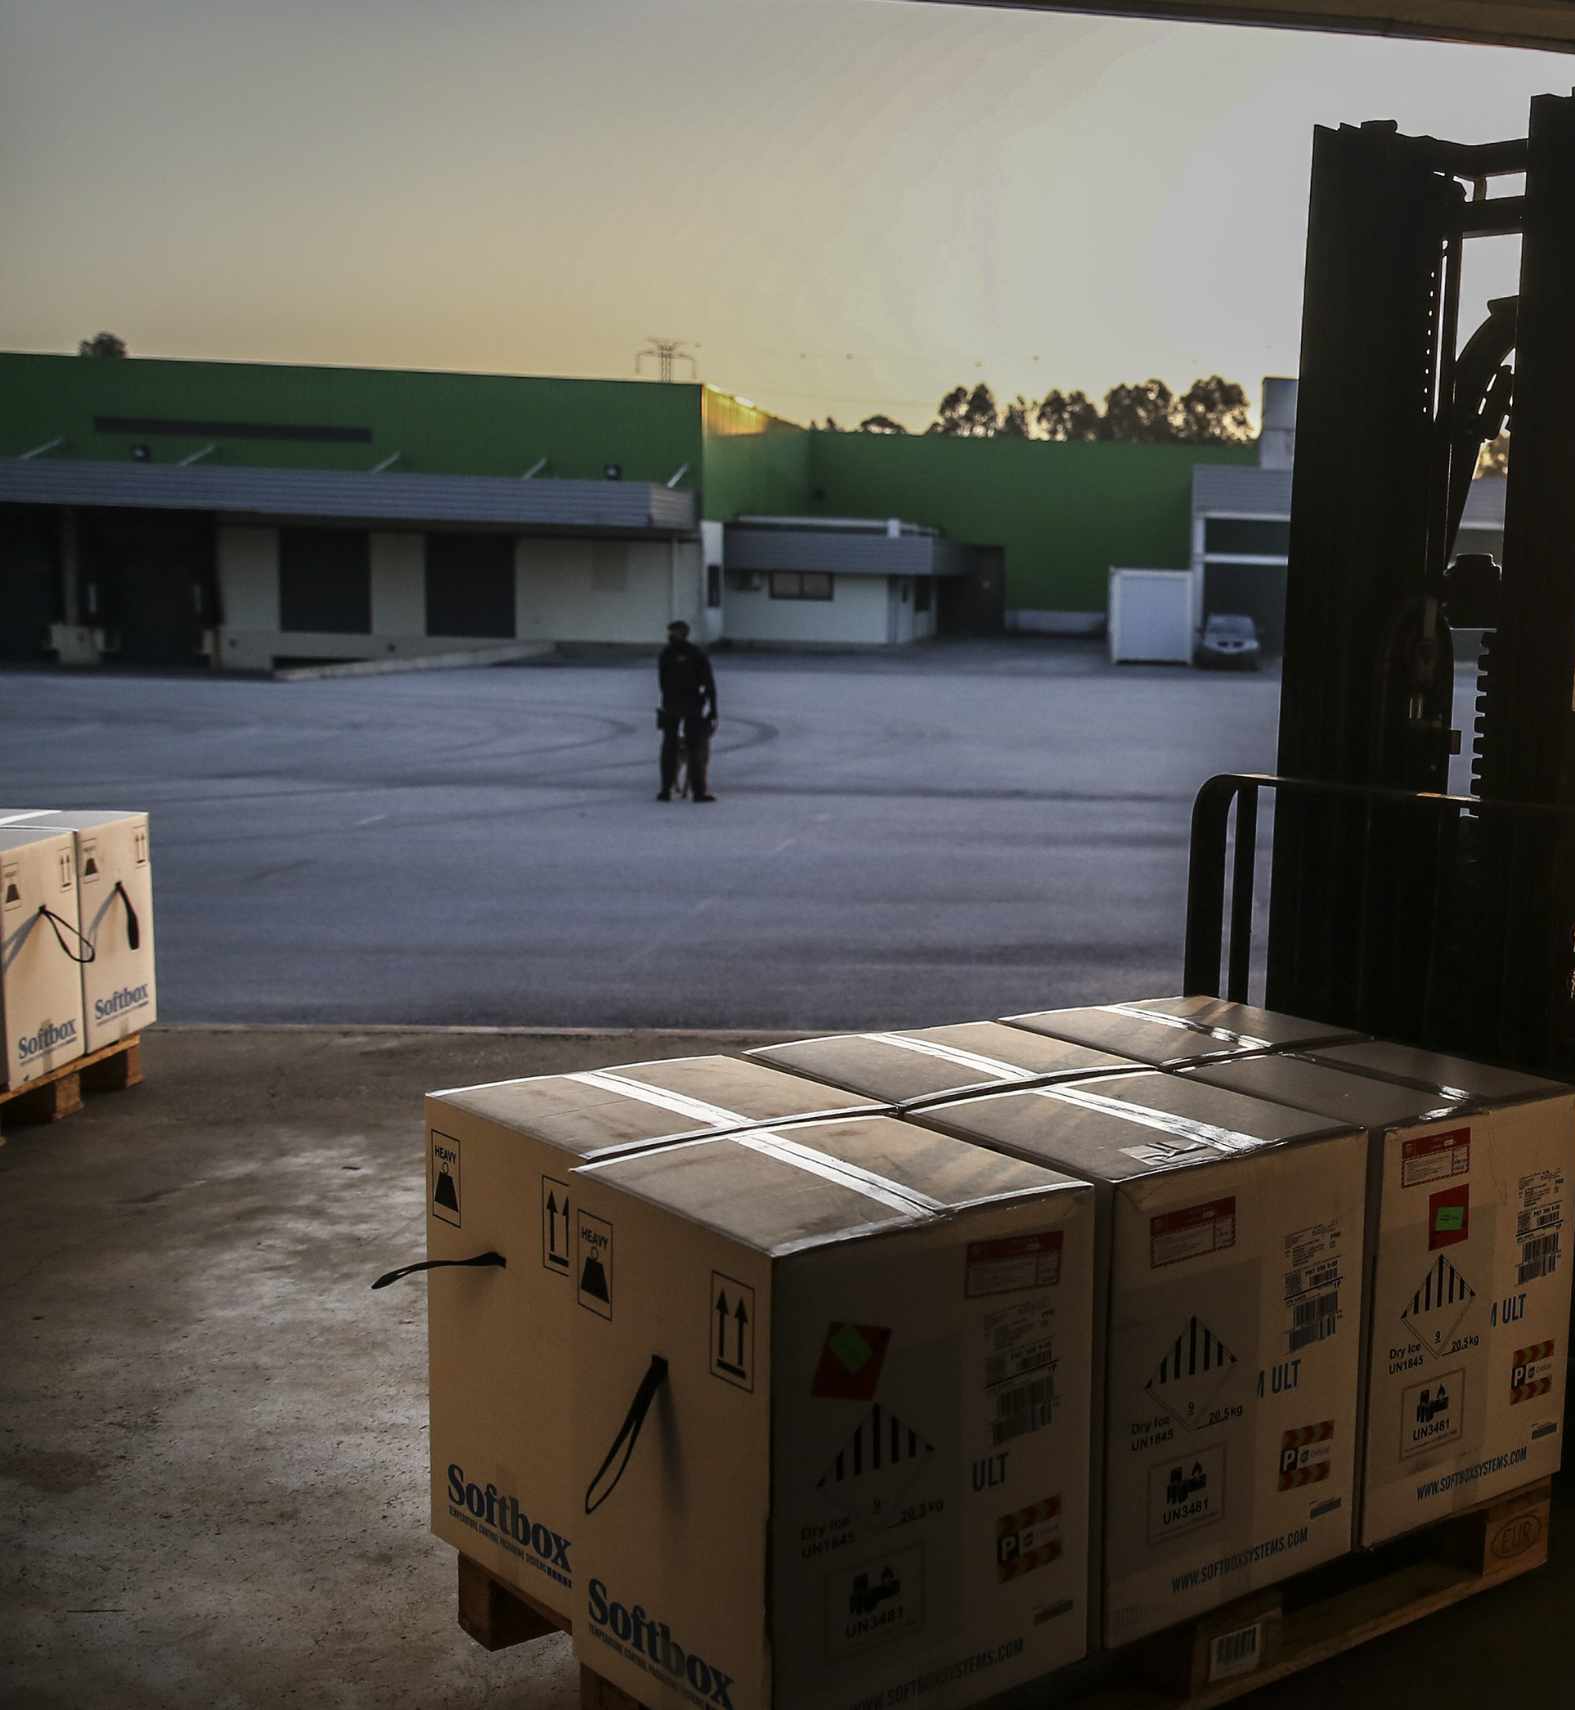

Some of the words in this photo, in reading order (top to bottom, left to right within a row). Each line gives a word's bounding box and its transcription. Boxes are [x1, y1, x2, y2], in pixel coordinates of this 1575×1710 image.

[94, 983, 149, 1019] Softbox
[18, 1019, 77, 1059] Softbox
[434, 1143, 457, 1164] HEAVY
[581, 1226, 609, 1251] HEAVY
[1502, 1292, 1527, 1325] ULT
[1271, 1359, 1301, 1394] ULT
[1388, 1355, 1425, 1375] UN1845
[1412, 1419, 1450, 1441] UN3481
[971, 1451, 1008, 1493] ULT
[447, 1463, 573, 1573] Softbox
[1162, 1499, 1209, 1525] UN3481
[587, 1577, 736, 1710] Softbox
